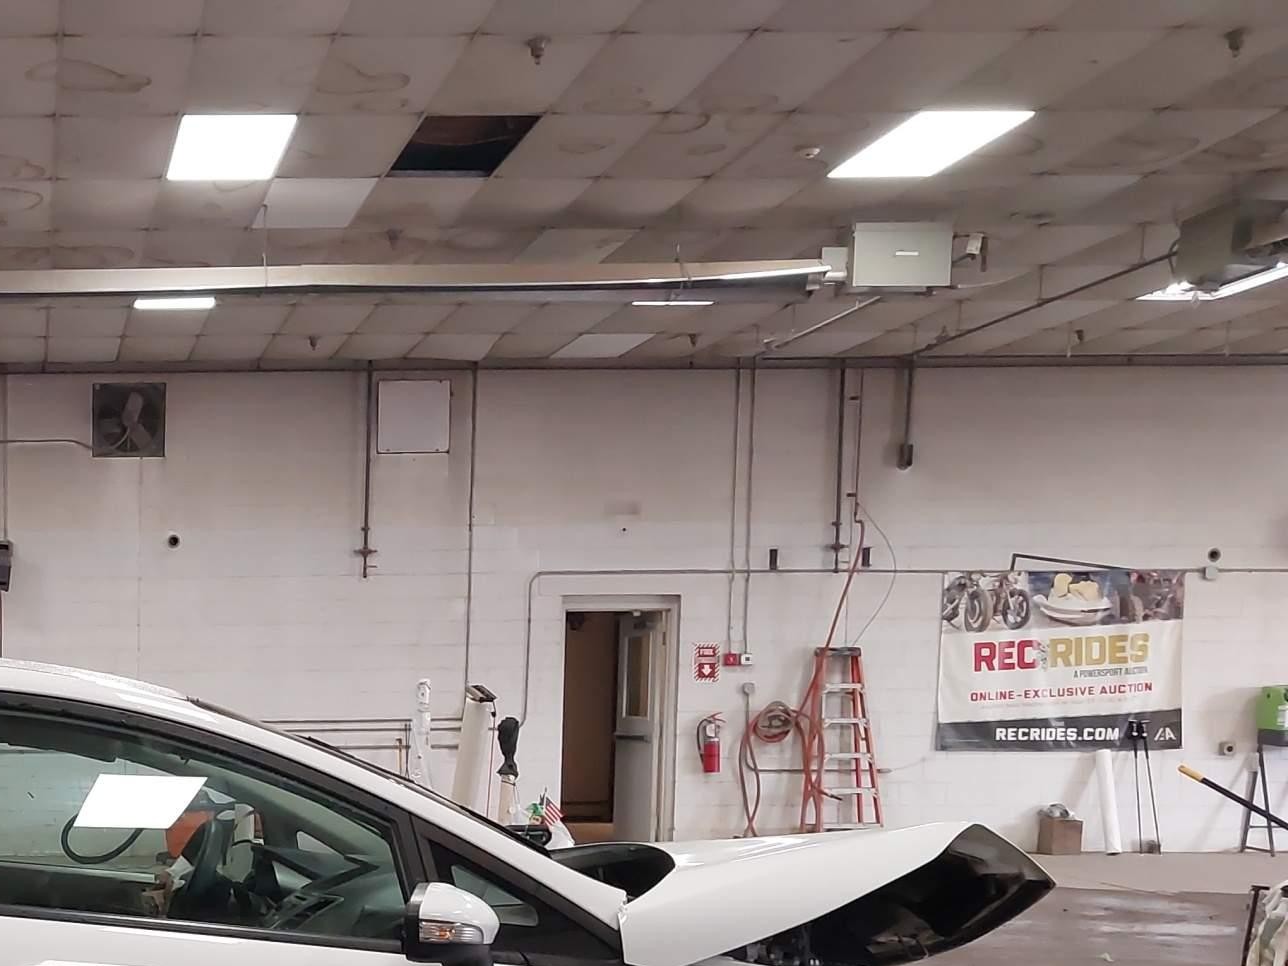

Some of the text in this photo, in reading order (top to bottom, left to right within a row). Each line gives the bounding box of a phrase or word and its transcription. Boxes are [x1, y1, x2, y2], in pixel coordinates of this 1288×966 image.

[973, 633, 1150, 672] REC RIDES
[970, 682, 1153, 701] ONLINE-EXCLUSIVE AUCTION
[995, 727, 1120, 741] RECRIDES.COM
